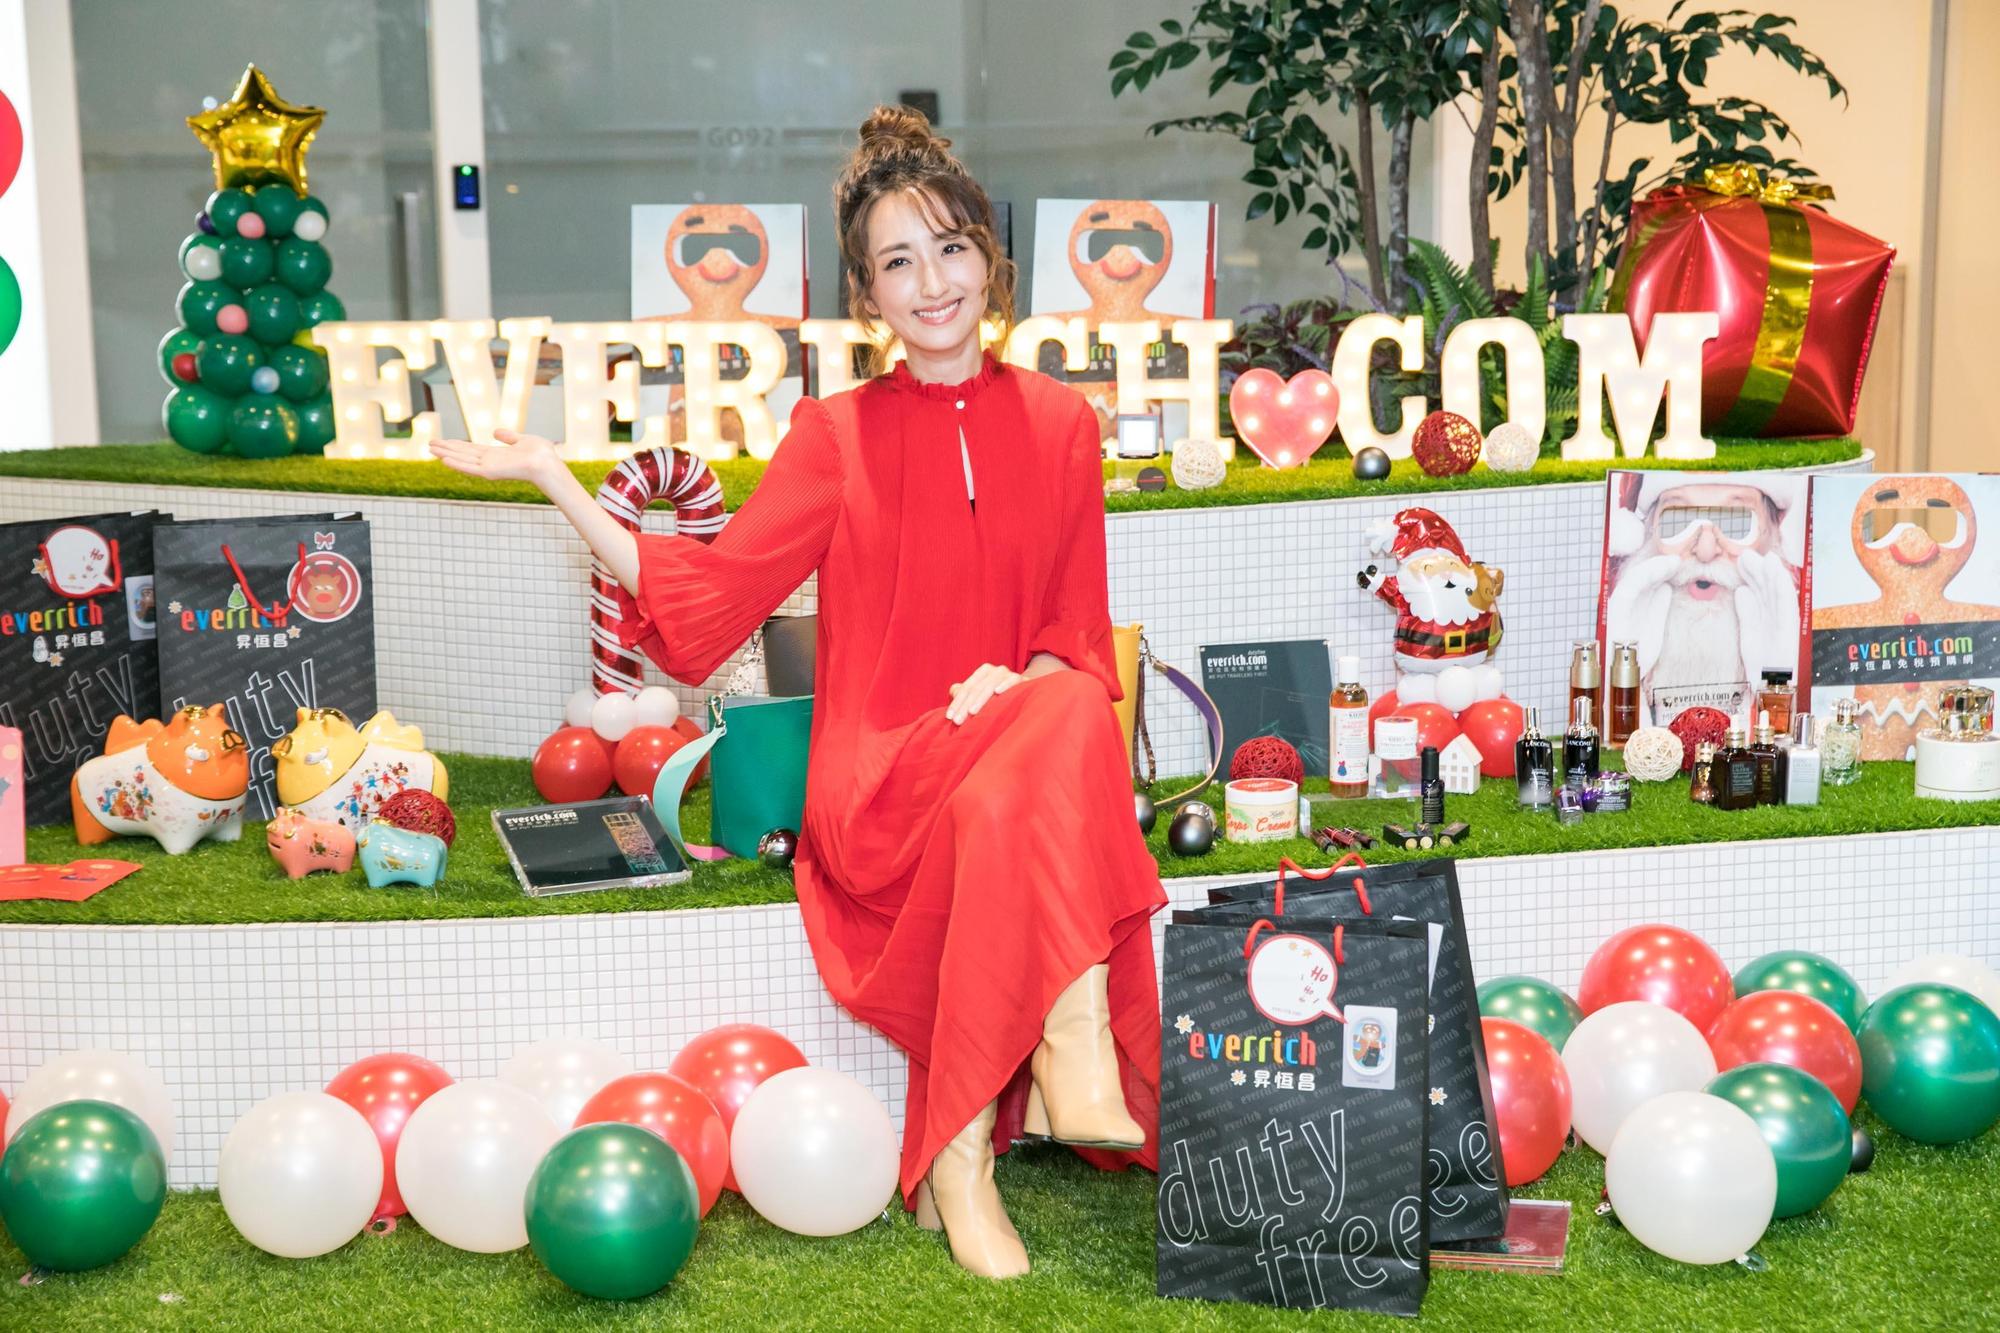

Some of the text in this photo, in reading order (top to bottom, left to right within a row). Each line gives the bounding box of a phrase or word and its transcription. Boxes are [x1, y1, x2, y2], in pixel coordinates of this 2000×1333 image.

[1331, 312, 1720, 461] COM
[1, 600, 104, 636] everrich
[1206, 654, 1268, 668] everrich.com
[1848, 635, 1974, 661] everrich.com
[505, 809, 578, 826] everrich.com
[1310, 965, 1329, 982] Ho
[1189, 1030, 1317, 1067] everrich
[1159, 1108, 1346, 1248] duty
[1255, 1195, 1421, 1308] free
